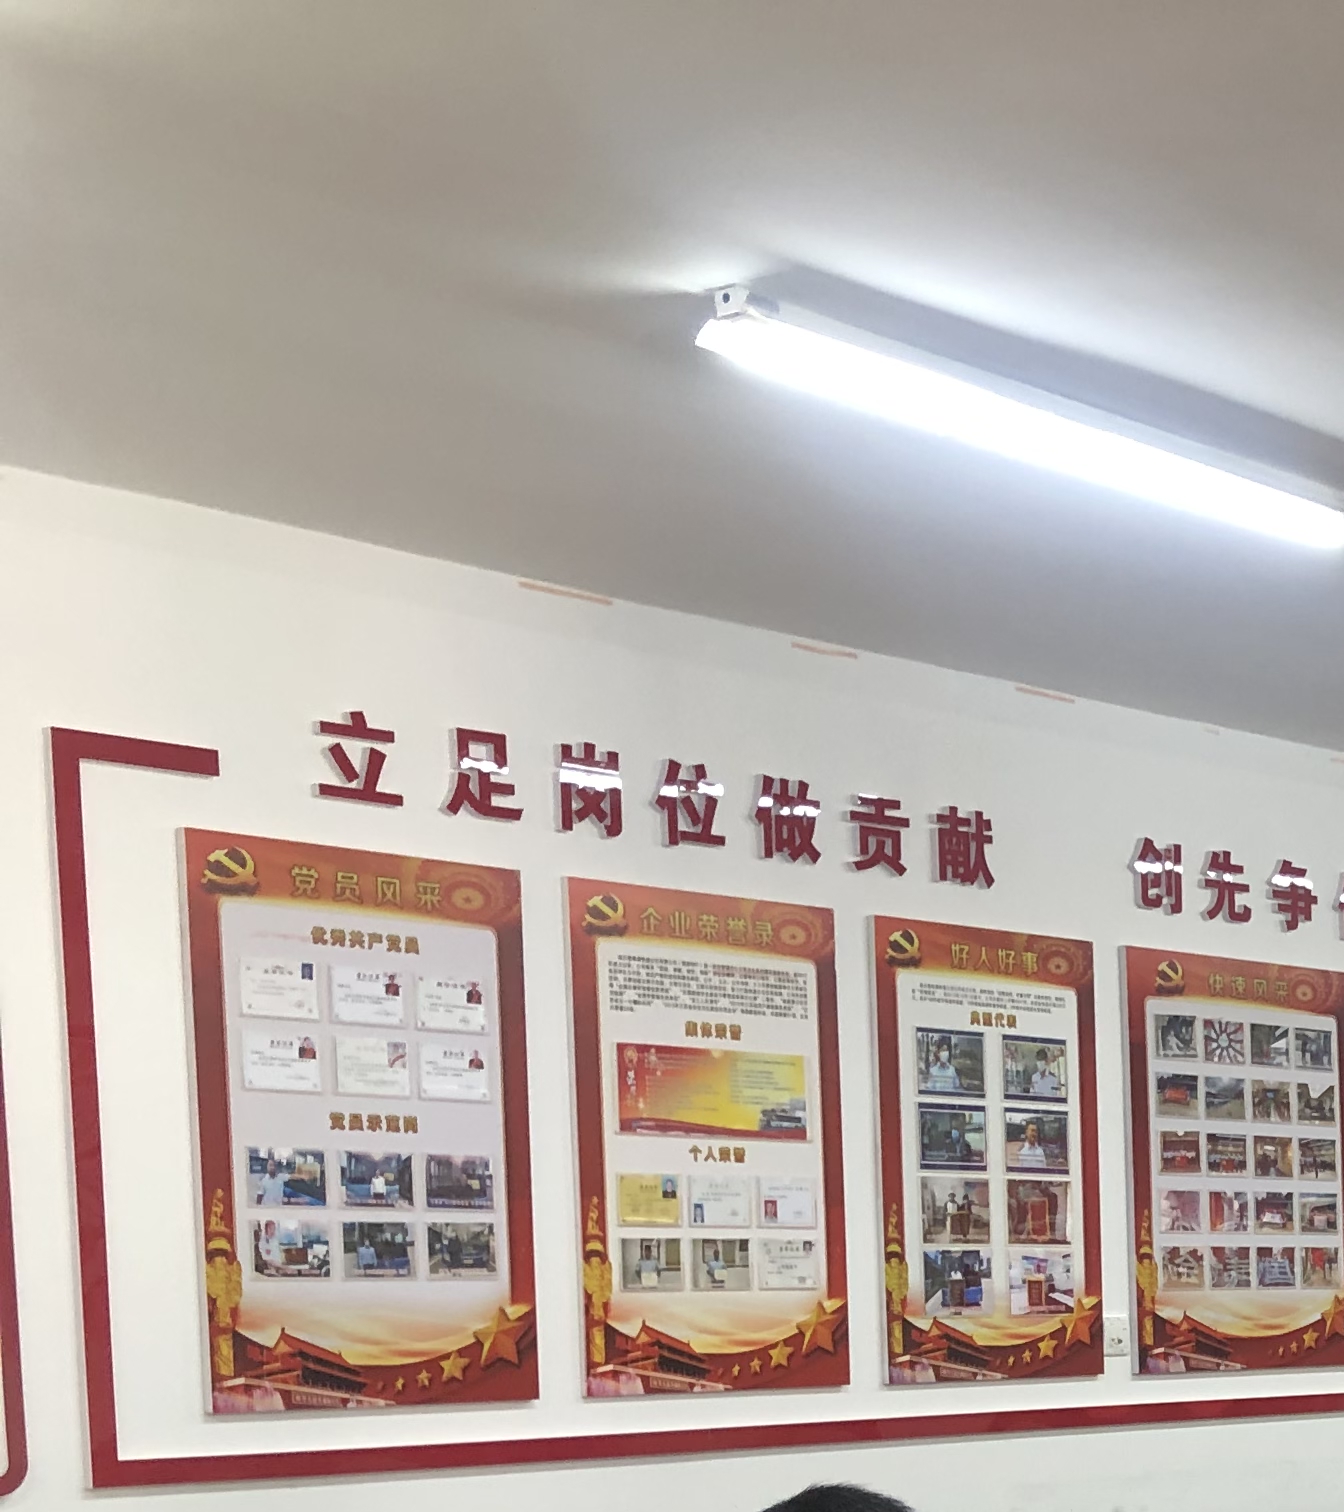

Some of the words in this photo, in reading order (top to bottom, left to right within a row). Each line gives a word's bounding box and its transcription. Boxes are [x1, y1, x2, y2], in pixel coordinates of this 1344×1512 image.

[312, 711, 995, 888] 立足岗位做贡献
[291, 865, 442, 911] 党员风采
[311, 926, 420, 955] 优秀共产党员
[640, 907, 774, 946] 企业荣誉录
[951, 942, 1038, 976] 好人好事
[1208, 973, 1289, 1001] 快速风采
[329, 1112, 419, 1134] 党员示范岗
